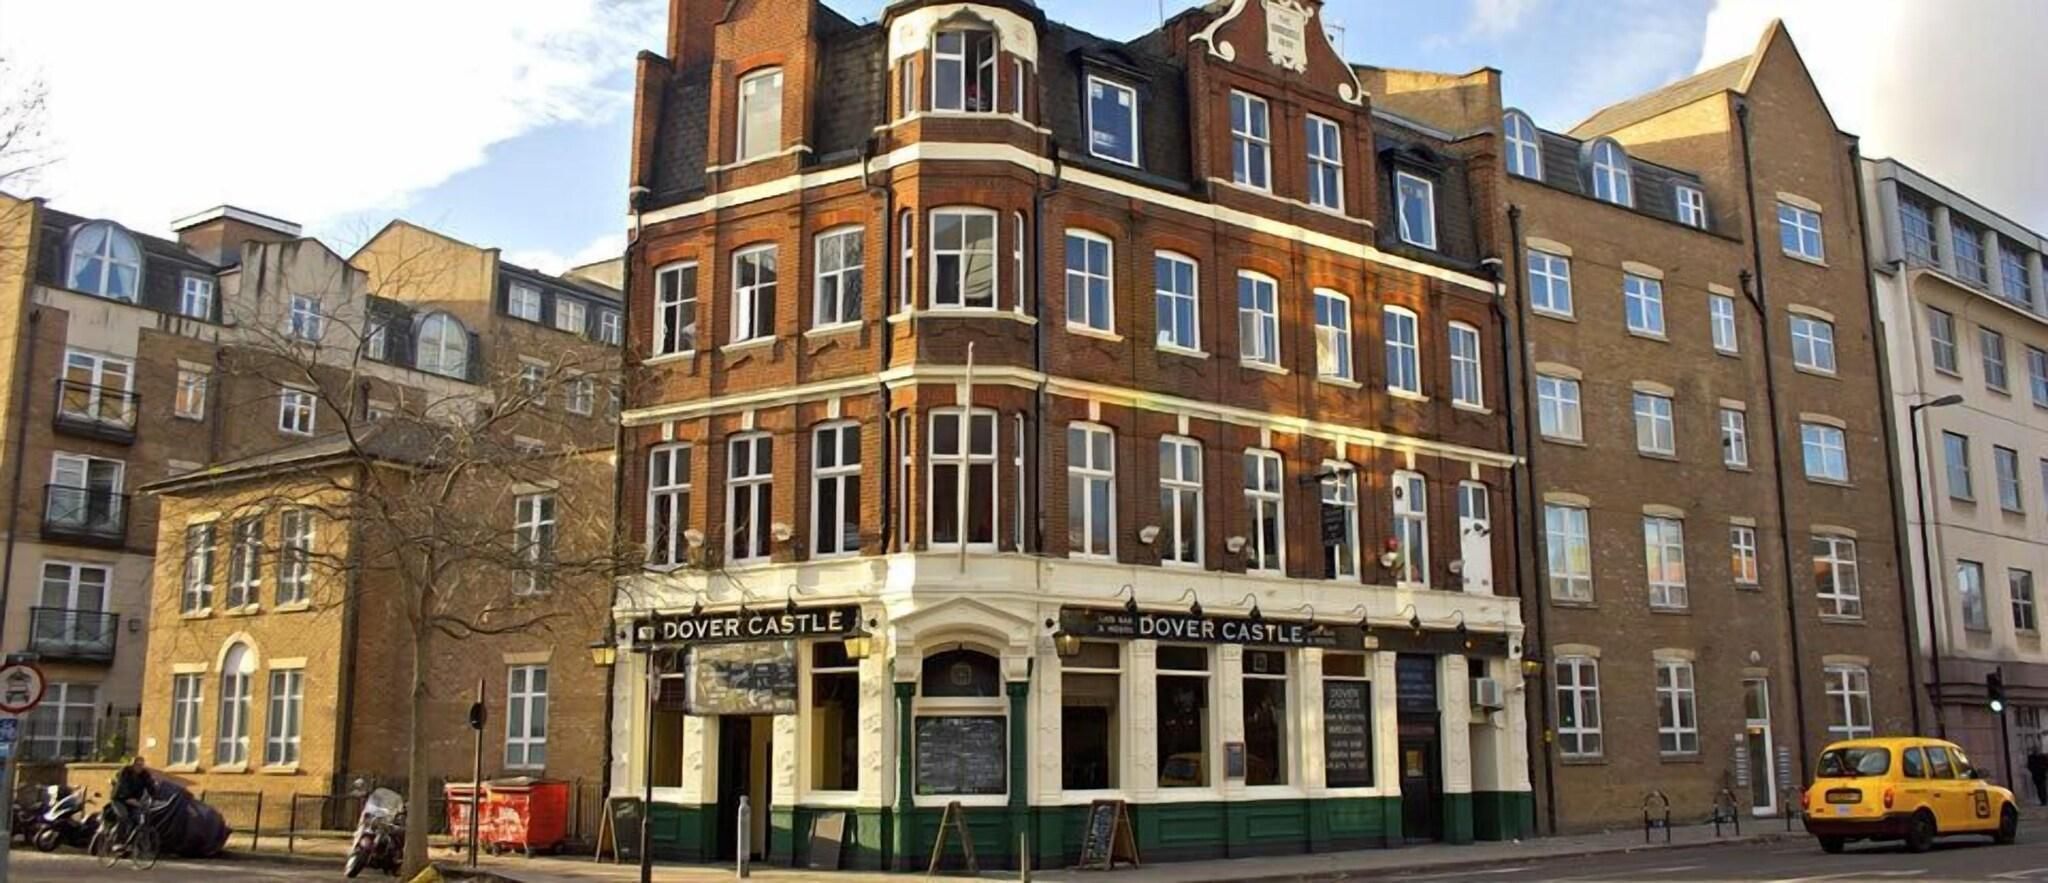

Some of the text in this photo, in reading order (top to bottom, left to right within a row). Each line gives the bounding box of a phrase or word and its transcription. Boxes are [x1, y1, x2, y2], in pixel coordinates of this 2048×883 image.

[663, 611, 844, 640] DOVER CASTLE
[1139, 616, 1216, 639] DOVER
[1222, 622, 1304, 643] CASTLE
[1329, 688, 1360, 698] DOVER
[1328, 699, 1361, 709] CASTLE
